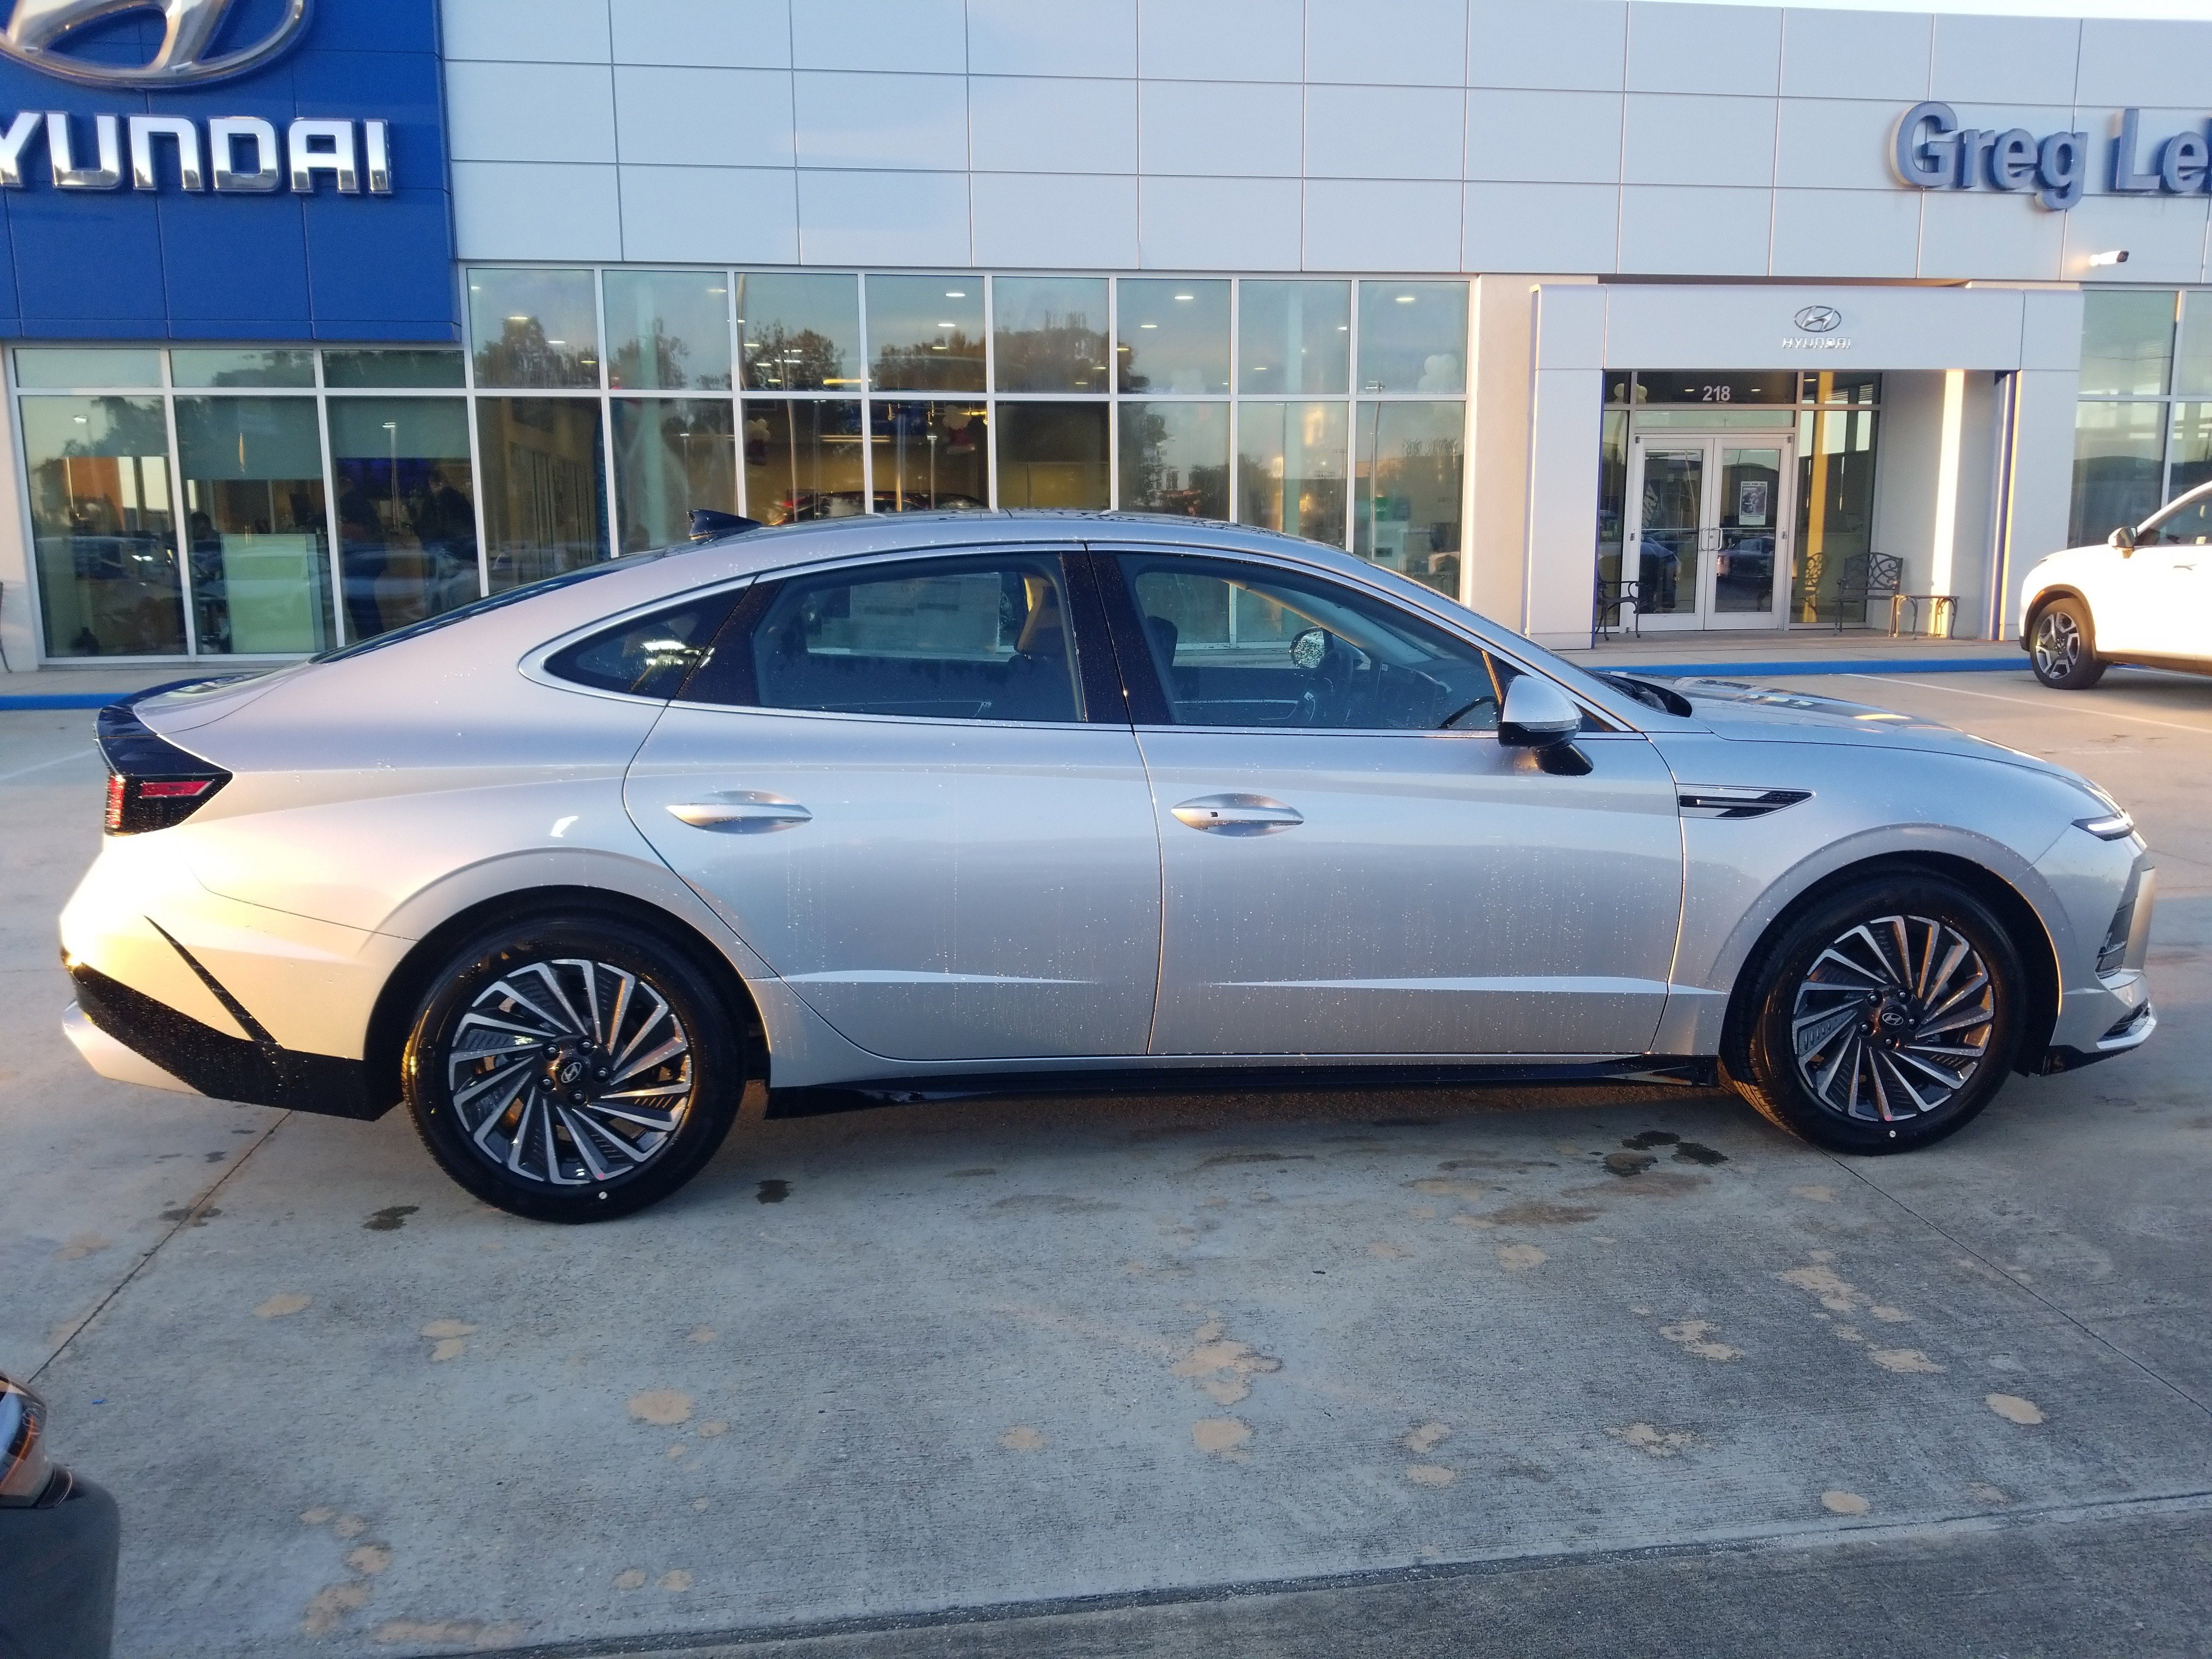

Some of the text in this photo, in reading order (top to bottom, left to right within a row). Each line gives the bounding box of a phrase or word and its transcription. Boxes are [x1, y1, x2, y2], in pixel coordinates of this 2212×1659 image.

[0, 111, 393, 195] YUNDAI
[1889, 100, 2212, 211] Greg Le
[1782, 336, 1851, 349] HYUNDAI
[1702, 385, 1730, 401] 218
